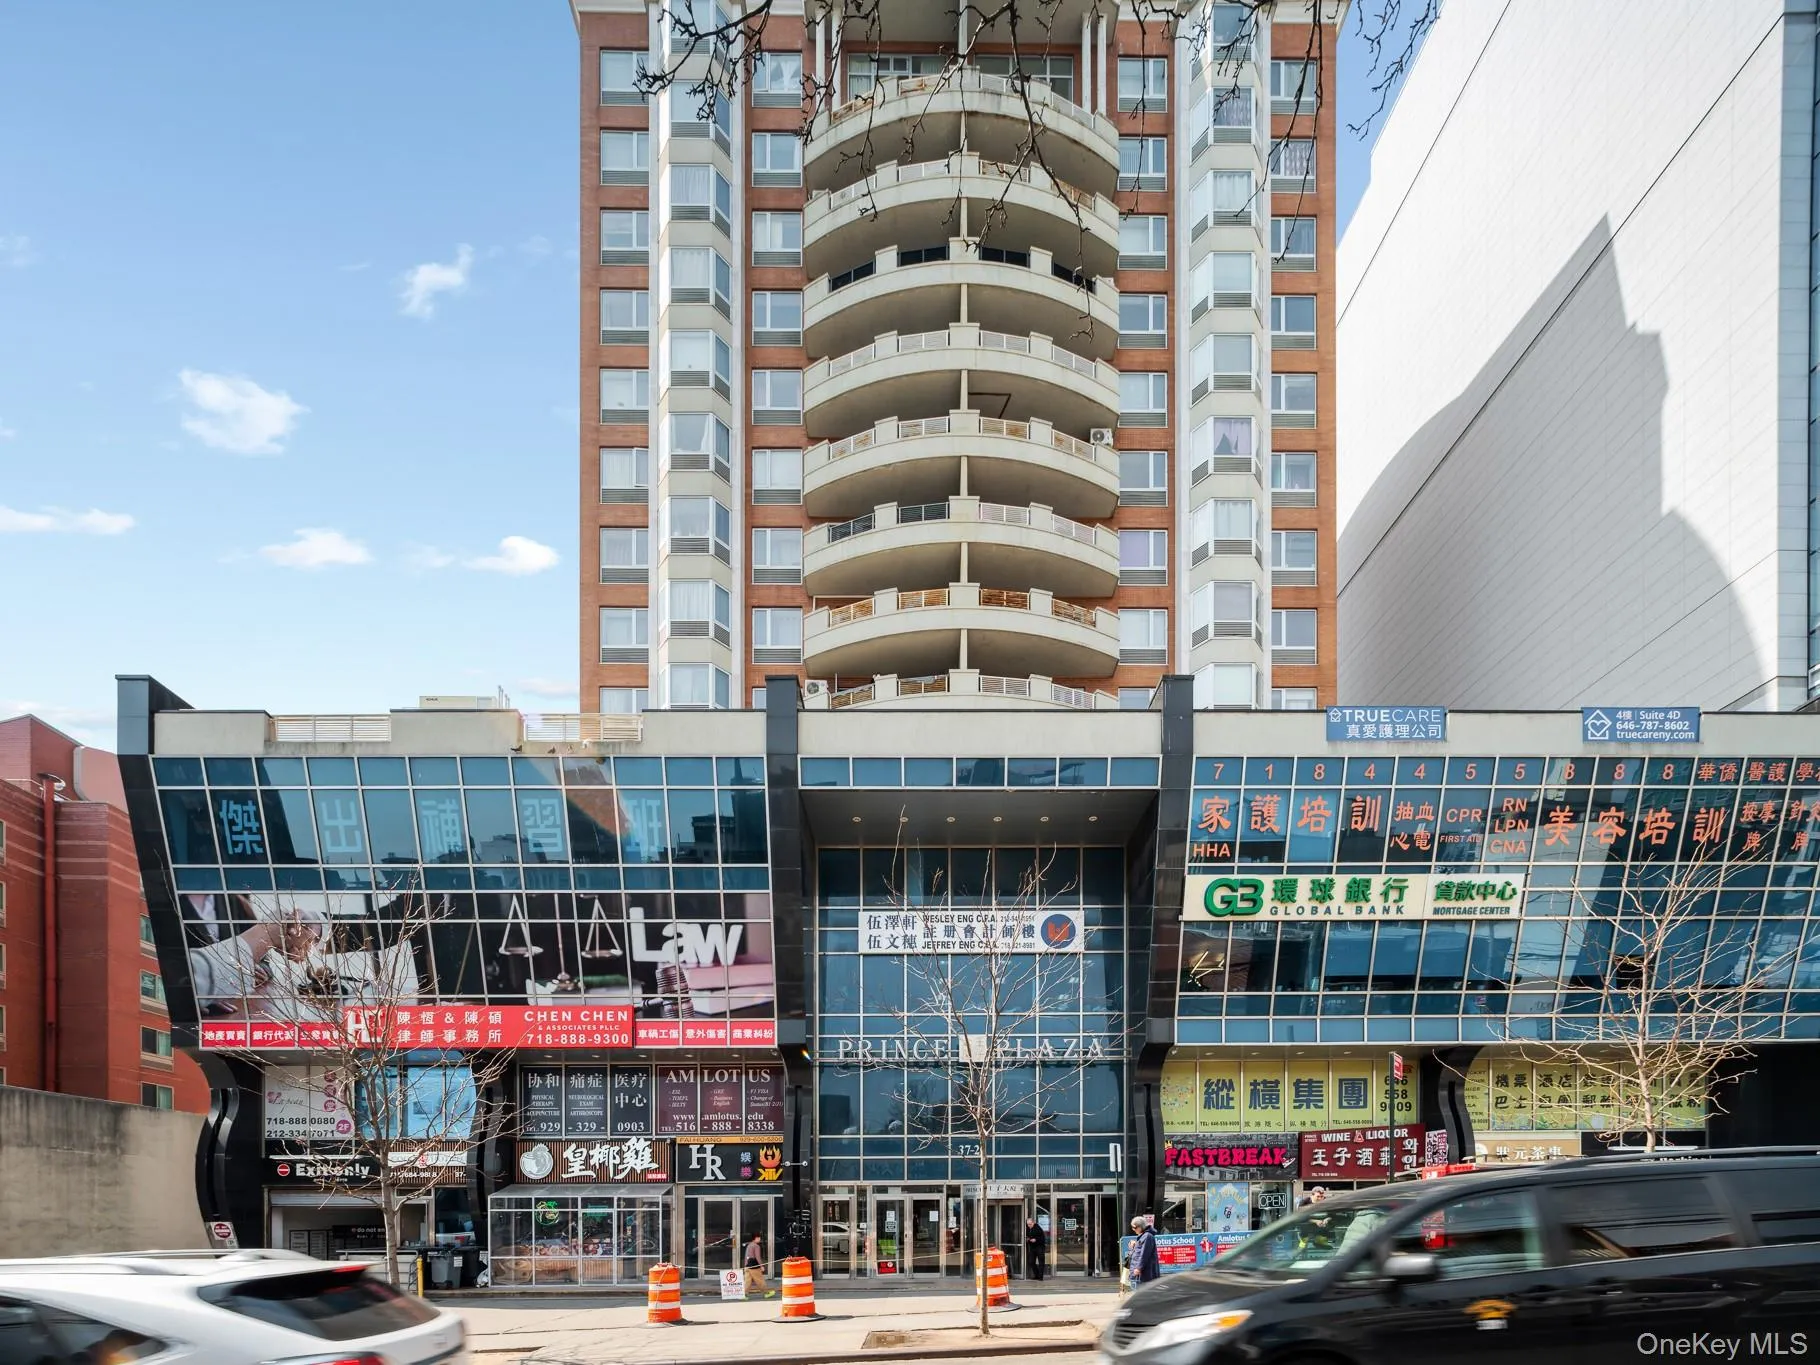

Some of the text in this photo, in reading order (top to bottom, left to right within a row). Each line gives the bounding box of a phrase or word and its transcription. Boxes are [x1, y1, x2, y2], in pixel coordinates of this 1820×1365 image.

[1342, 709, 1441, 722] TRUECARE
[1640, 710, 1665, 720] Suite
[1667, 710, 1681, 720] 4D
[1346, 724, 1442, 739] 真愛護理公司
[1616, 721, 1690, 730] 646-787-8602
[1616, 730, 1695, 742] truecareny.com
[1394, 801, 1435, 821] 抽血
[1502, 798, 1528, 812] RN
[1446, 808, 1482, 823] CPR
[1494, 818, 1529, 833] LPN
[1390, 830, 1432, 851] 心電
[1439, 835, 1466, 843] FIRST
[1489, 839, 1527, 854] CNA
[1193, 842, 1231, 858] HHA
[1272, 877, 1409, 903] 環球銀行
[1434, 880, 1518, 902] 貸款中心
[1269, 905, 1405, 916] GLOBAL BANK
[1432, 906, 1510, 916] MORTGAGE CENTER
[922, 914, 955, 923] WESLEY
[958, 914, 974, 923] ENG
[629, 906, 743, 966] Law
[922, 941, 956, 949] JEFFREY
[959, 941, 975, 949] ENG
[524, 1011, 629, 1022] CHEN CHEN
[397, 1029, 502, 1044] 律師事務所
[526, 1033, 629, 1045] 718-888-9300
[838, 1039, 948, 1060] PRINCE
[997, 1039, 1105, 1060] PLAZA
[615, 1092, 647, 1108] 中心
[1203, 1077, 1369, 1111] 縱橫集團
[1379, 1101, 1412, 1112] 909
[1321, 1132, 1351, 1143] WINE
[561, 1135, 659, 1180] 皇椰雞
[688, 1144, 726, 1180] HR
[1164, 1147, 1287, 1167] FASTBREAK
[1260, 1195, 1285, 1207] OPEN
[1173, 1236, 1196, 1246] School
